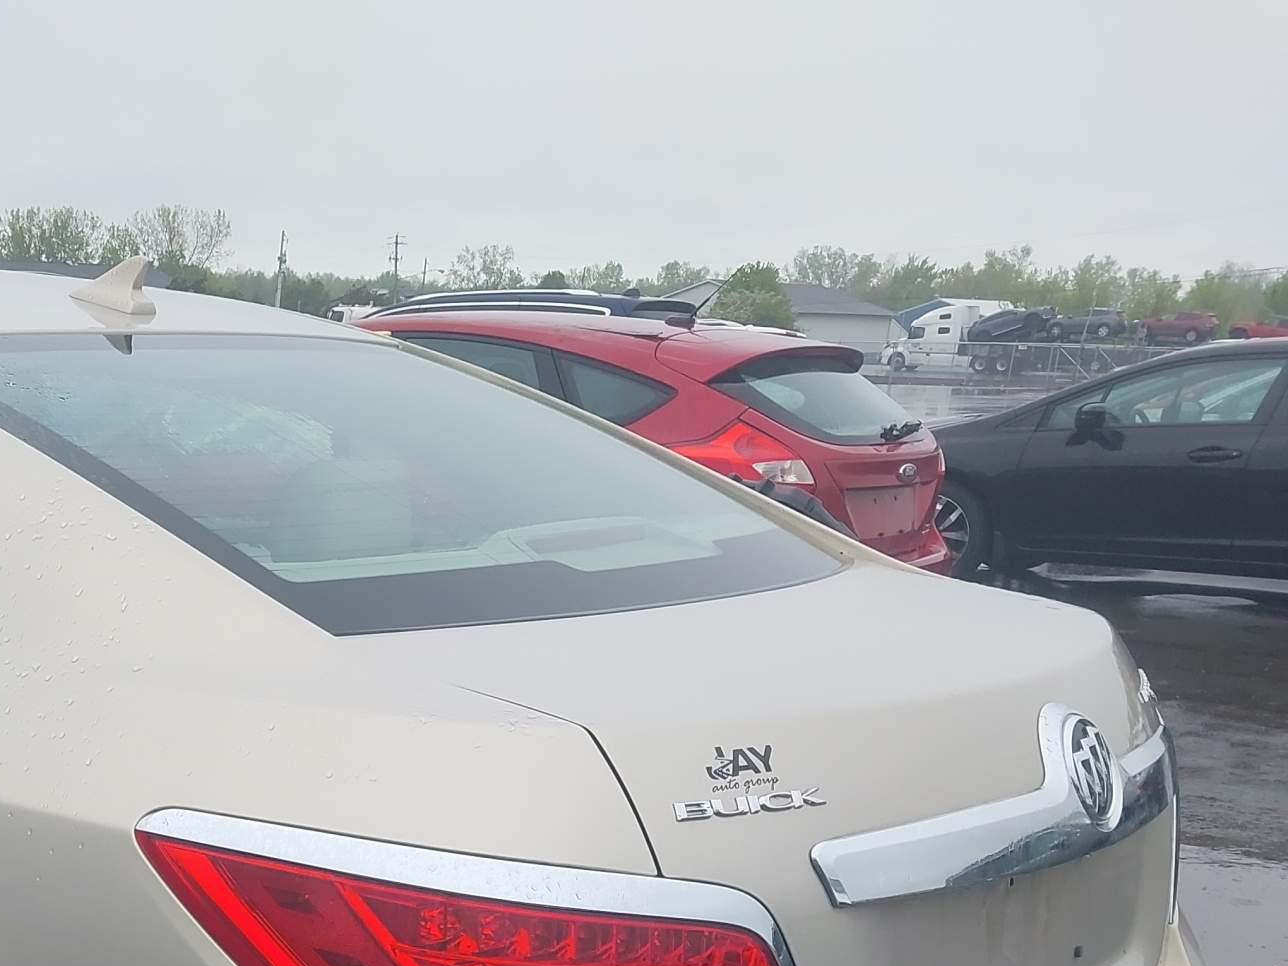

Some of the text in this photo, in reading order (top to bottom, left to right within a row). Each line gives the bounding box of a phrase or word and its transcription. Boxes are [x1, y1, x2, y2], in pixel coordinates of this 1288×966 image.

[705, 744, 773, 780] JAY
[712, 776, 779, 794] auto group
[672, 787, 827, 822] BUICK
